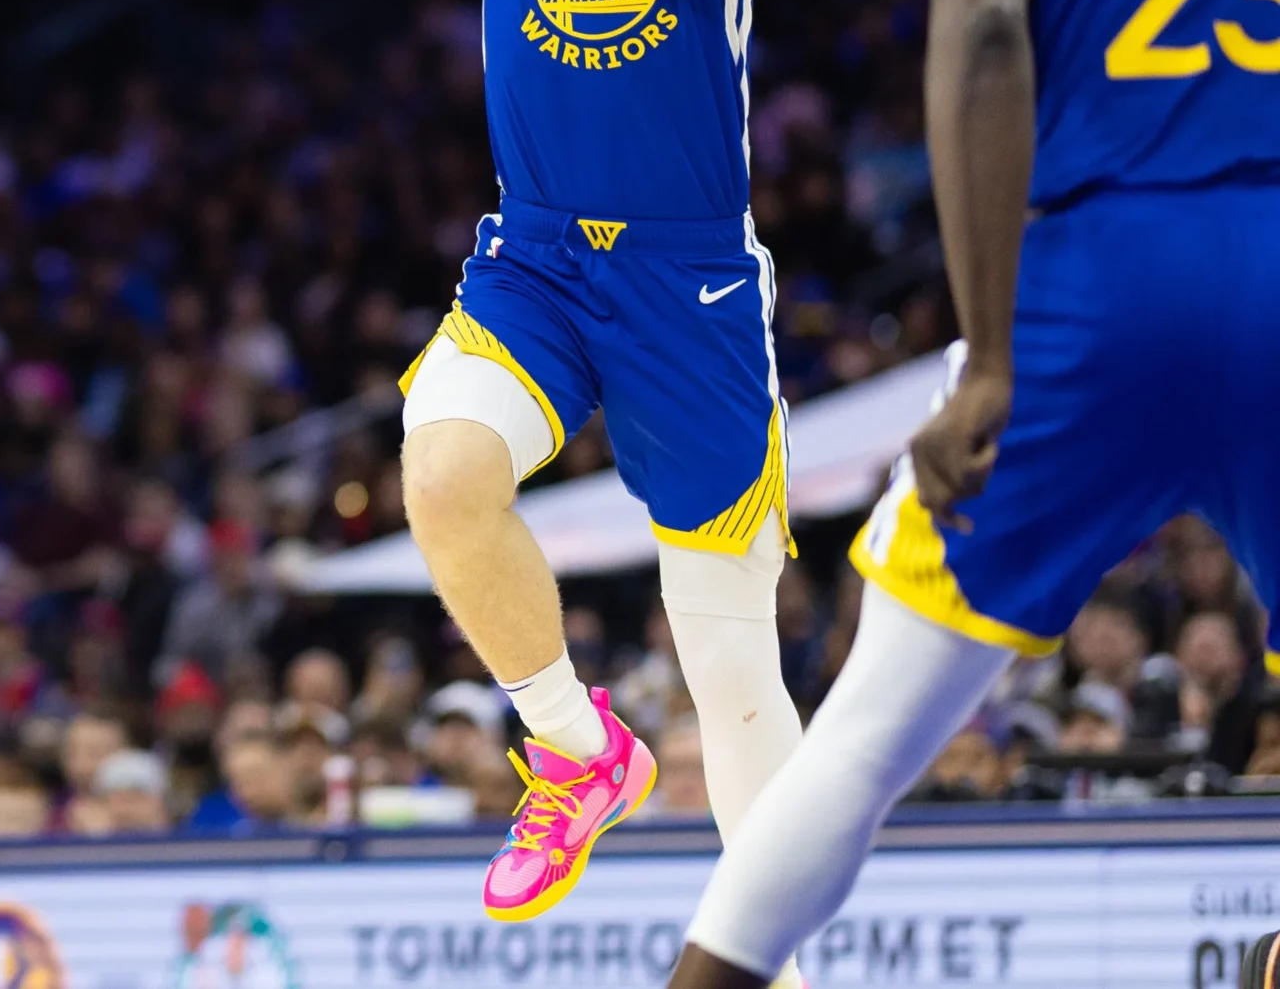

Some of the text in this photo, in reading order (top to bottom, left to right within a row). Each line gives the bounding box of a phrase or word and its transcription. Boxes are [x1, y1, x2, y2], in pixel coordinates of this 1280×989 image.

[520, 8, 678, 71] WARRIORS
[348, 921, 686, 983] TOMORRO
[804, 917, 920, 981] PM
